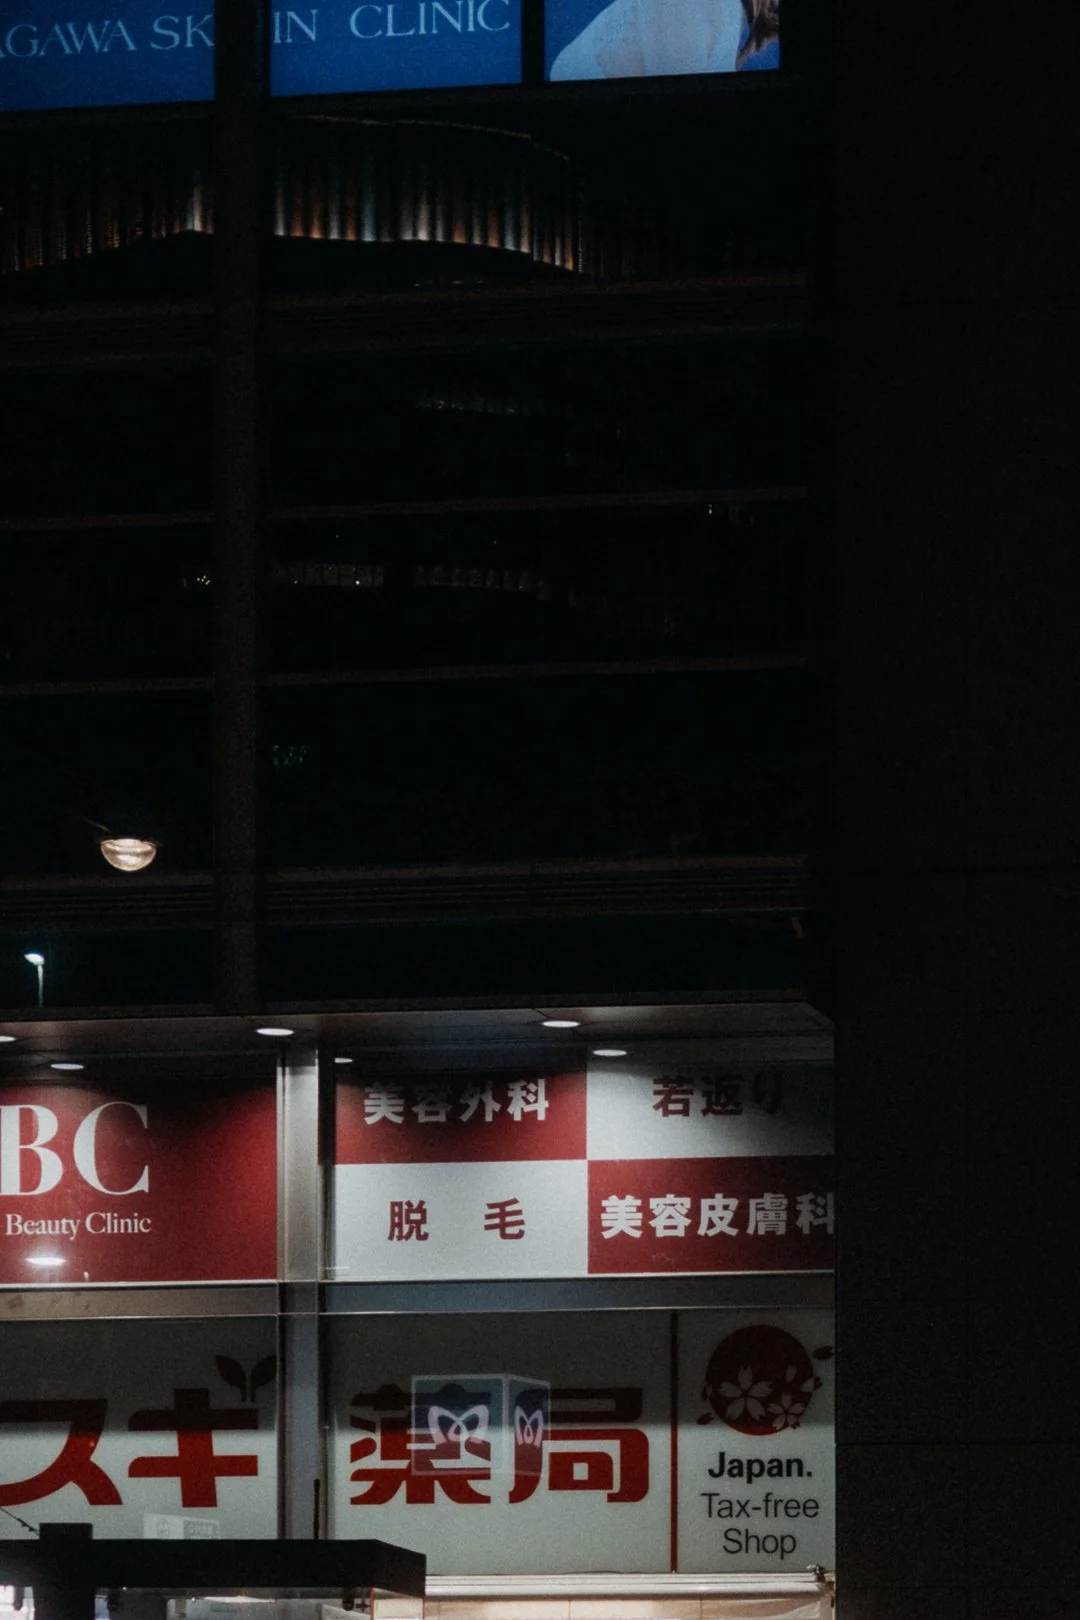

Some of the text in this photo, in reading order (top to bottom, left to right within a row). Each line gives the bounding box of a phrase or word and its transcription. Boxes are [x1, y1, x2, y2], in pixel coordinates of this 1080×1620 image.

[0, 18, 137, 60] GAWA
[350, 0, 512, 40] CLINIC
[363, 1078, 551, 1124] 美容外科
[652, 1075, 784, 1118] 若返り
[5, 1211, 152, 1241] Beauty Clinic
[601, 1192, 835, 1240] 美容皮膚科
[708, 1451, 814, 1484] Japan.
[701, 1492, 820, 1520] Tax-free
[723, 1528, 797, 1560] Shop
